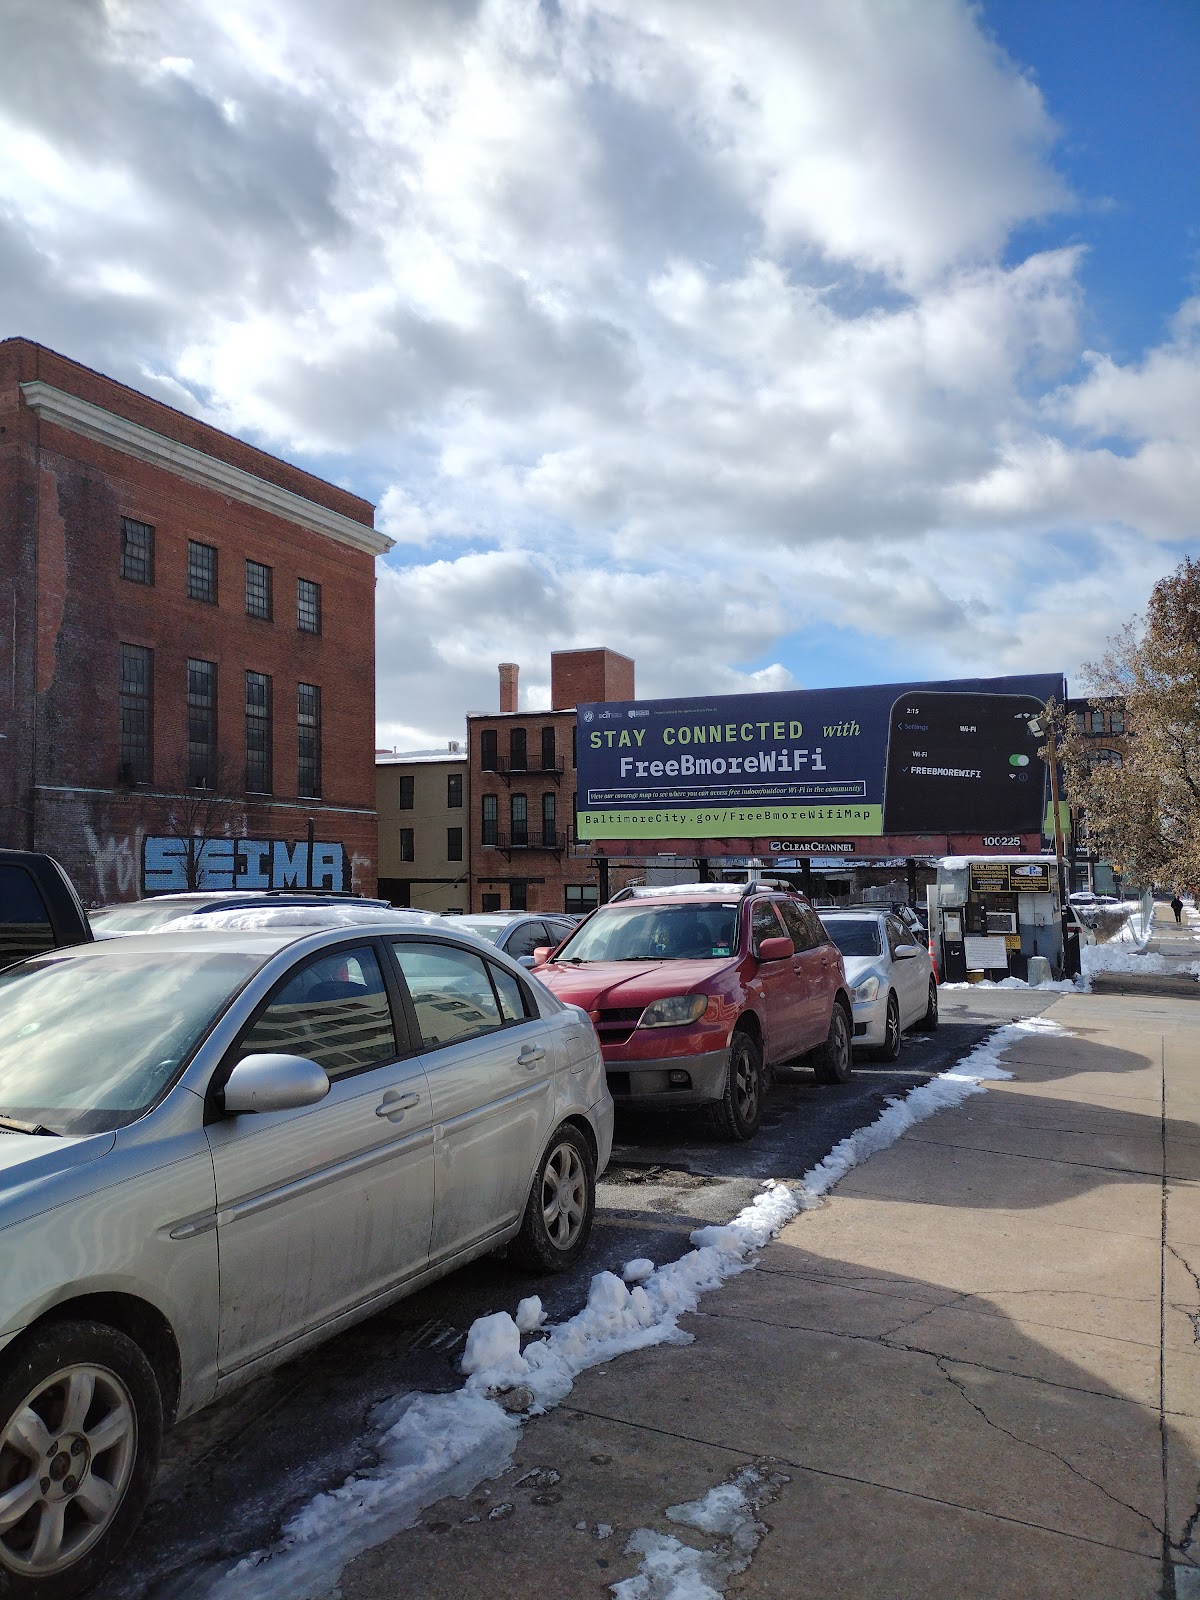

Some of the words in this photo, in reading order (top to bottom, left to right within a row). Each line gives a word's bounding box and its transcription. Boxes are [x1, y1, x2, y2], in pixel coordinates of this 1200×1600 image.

[590, 730, 646, 748] STAY
[662, 721, 803, 745] CONNECTED
[822, 720, 860, 738] with
[904, 723, 928, 732] Settings
[620, 748, 826, 777] FreeBmoreWiFi
[910, 766, 982, 778] FREEBMOREWIFI
[728, 788, 740, 796] free
[741, 787, 788, 795] indoor/outdoor
[586, 809, 870, 824] BaltimoreCity.gov/FreeBmoreWifiMap
